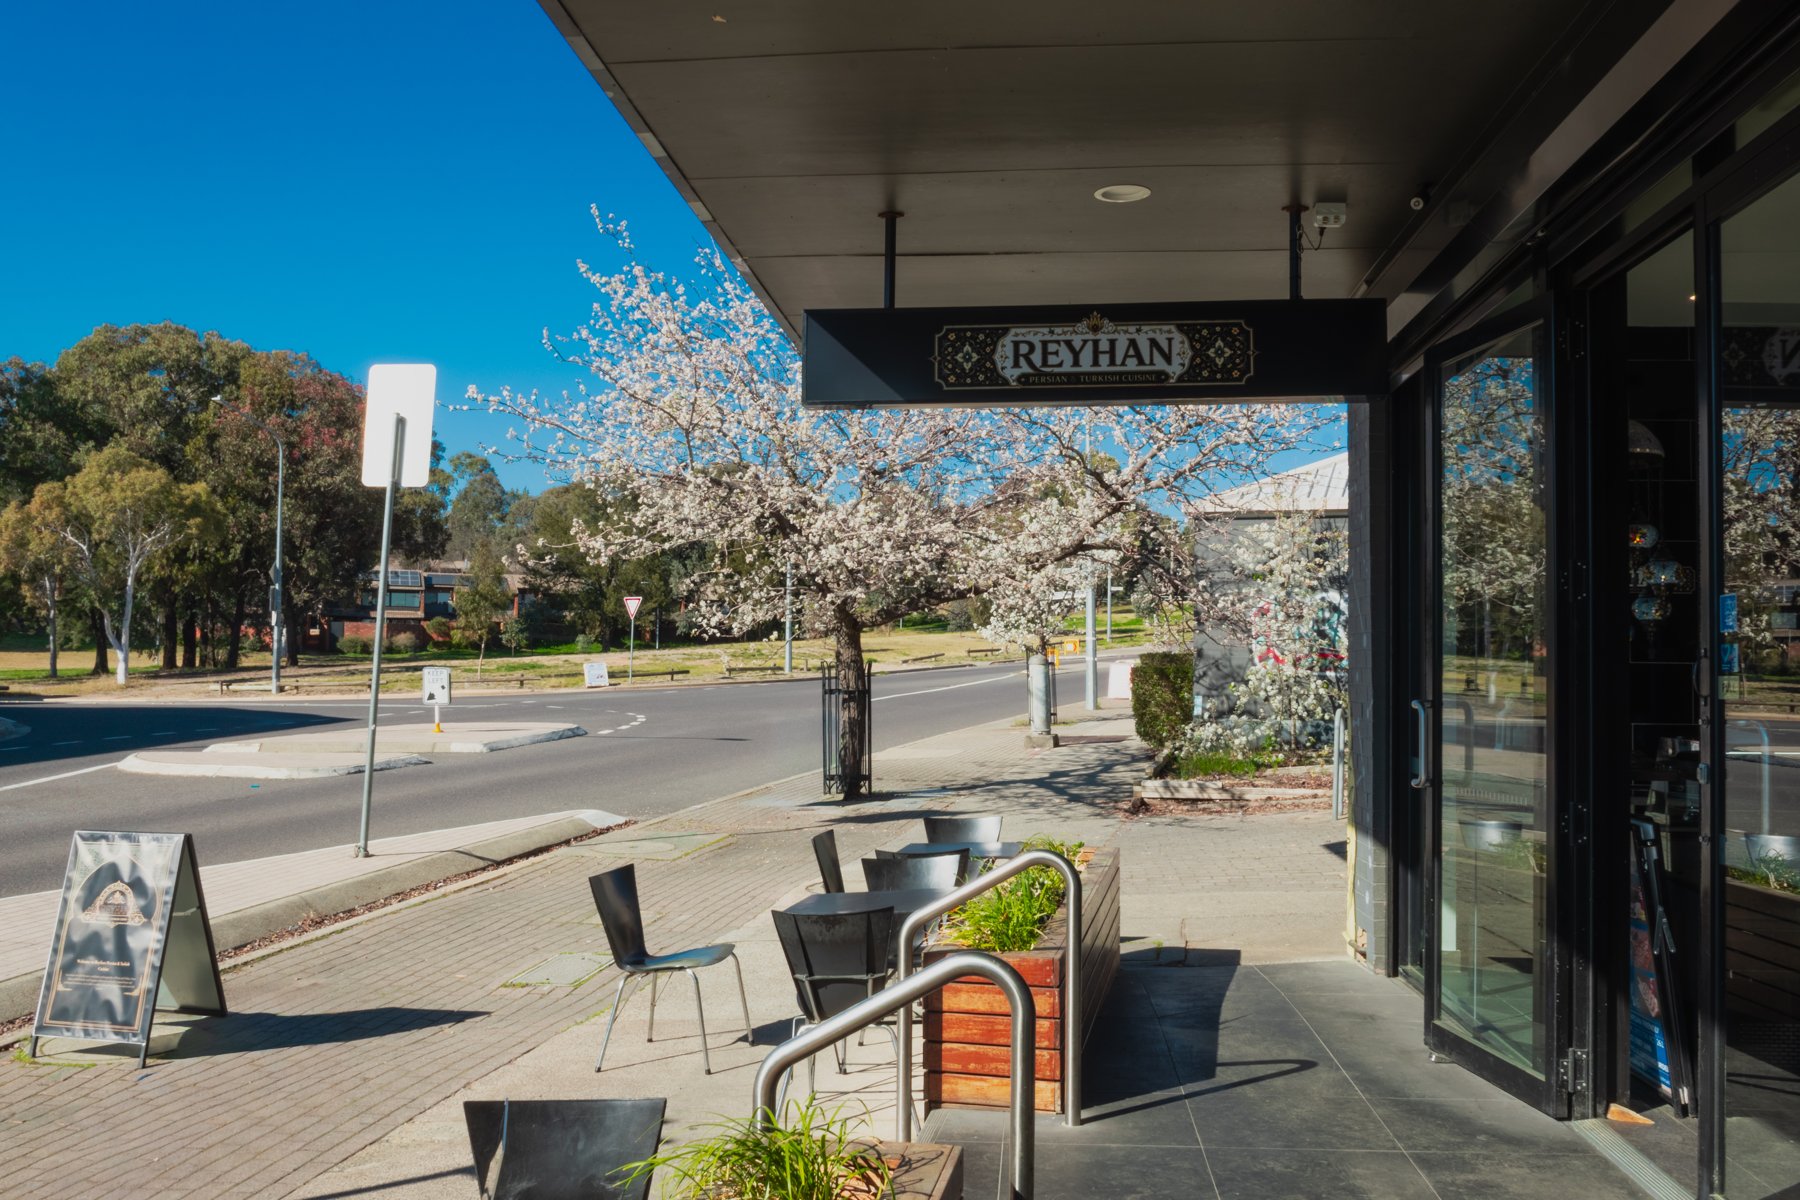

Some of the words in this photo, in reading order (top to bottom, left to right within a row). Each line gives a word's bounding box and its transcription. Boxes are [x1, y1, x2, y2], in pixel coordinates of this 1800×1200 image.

[1011, 337, 1175, 372] REYHAN
[1029, 375, 1068, 384] PERSIAN
[1080, 374, 1120, 383] TURKISH
[1122, 374, 1156, 382] CUISINE
